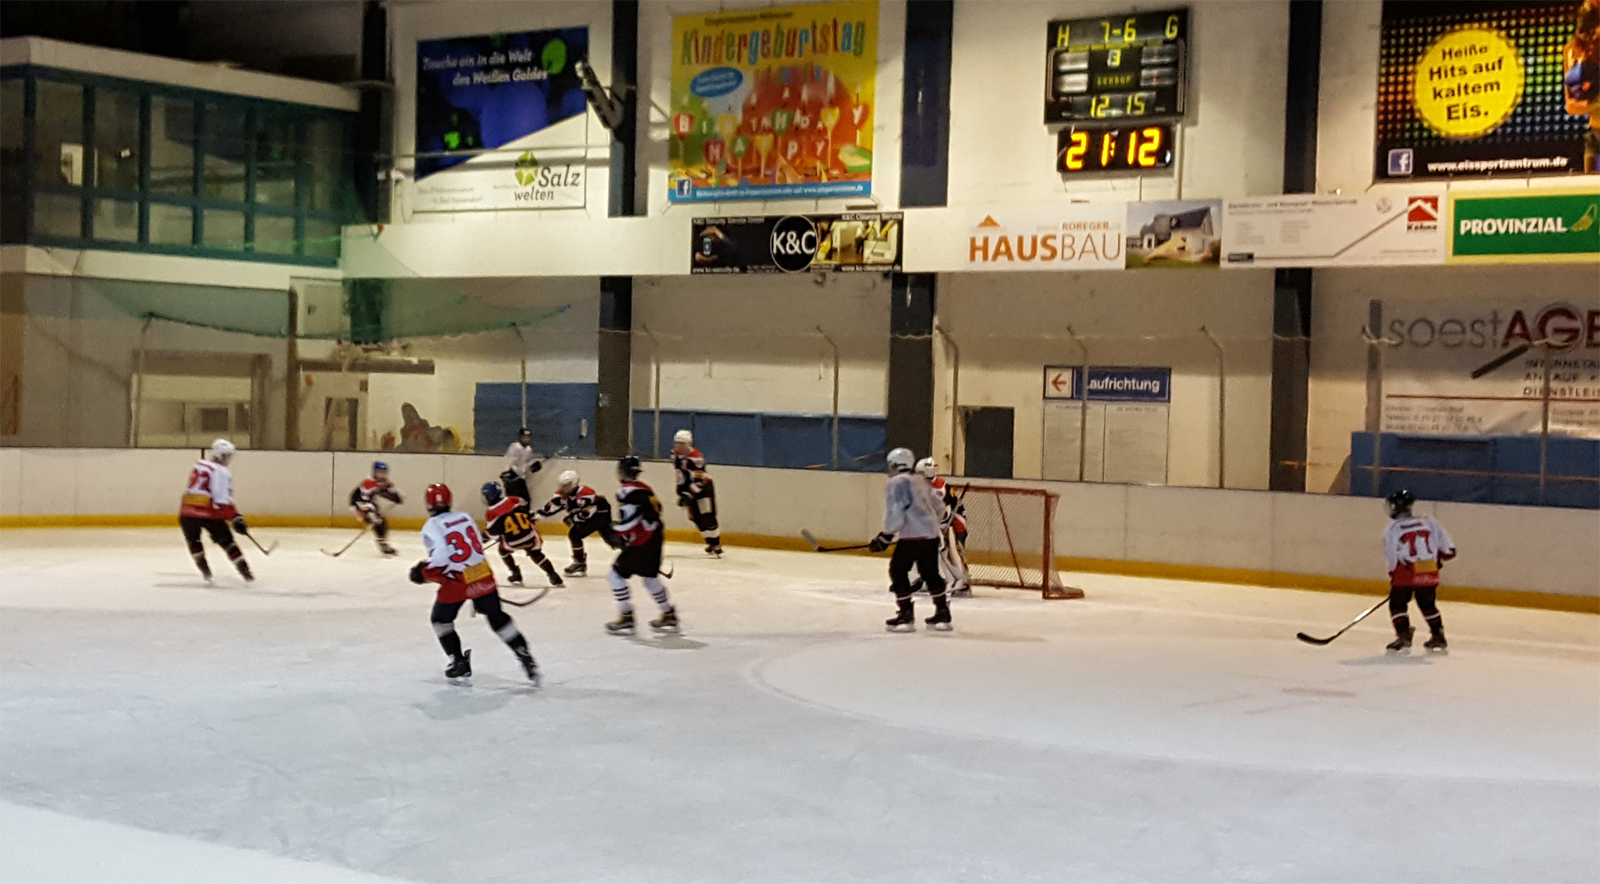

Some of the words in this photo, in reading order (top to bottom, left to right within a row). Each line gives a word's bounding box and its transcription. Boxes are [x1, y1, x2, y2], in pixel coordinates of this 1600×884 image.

[1057, 24, 1070, 48] H
[1165, 15, 1178, 39] G
[682, 18, 866, 66] Kindergeburtstag
[1441, 44, 1488, 61] Heiße
[508, 48, 533, 63] Welt
[512, 66, 548, 81] Goldes
[1429, 64, 1468, 81] Hits
[1473, 57, 1505, 76] auf
[1433, 80, 1501, 100] kaltem
[1446, 103, 1490, 121] Eis.
[1066, 127, 1161, 170] 21:12
[538, 164, 581, 187] Salz
[514, 187, 554, 201] welten
[1460, 217, 1567, 235] PROVINZIAL
[772, 231, 816, 255] K&C
[969, 233, 1121, 262] HAUSBAU
